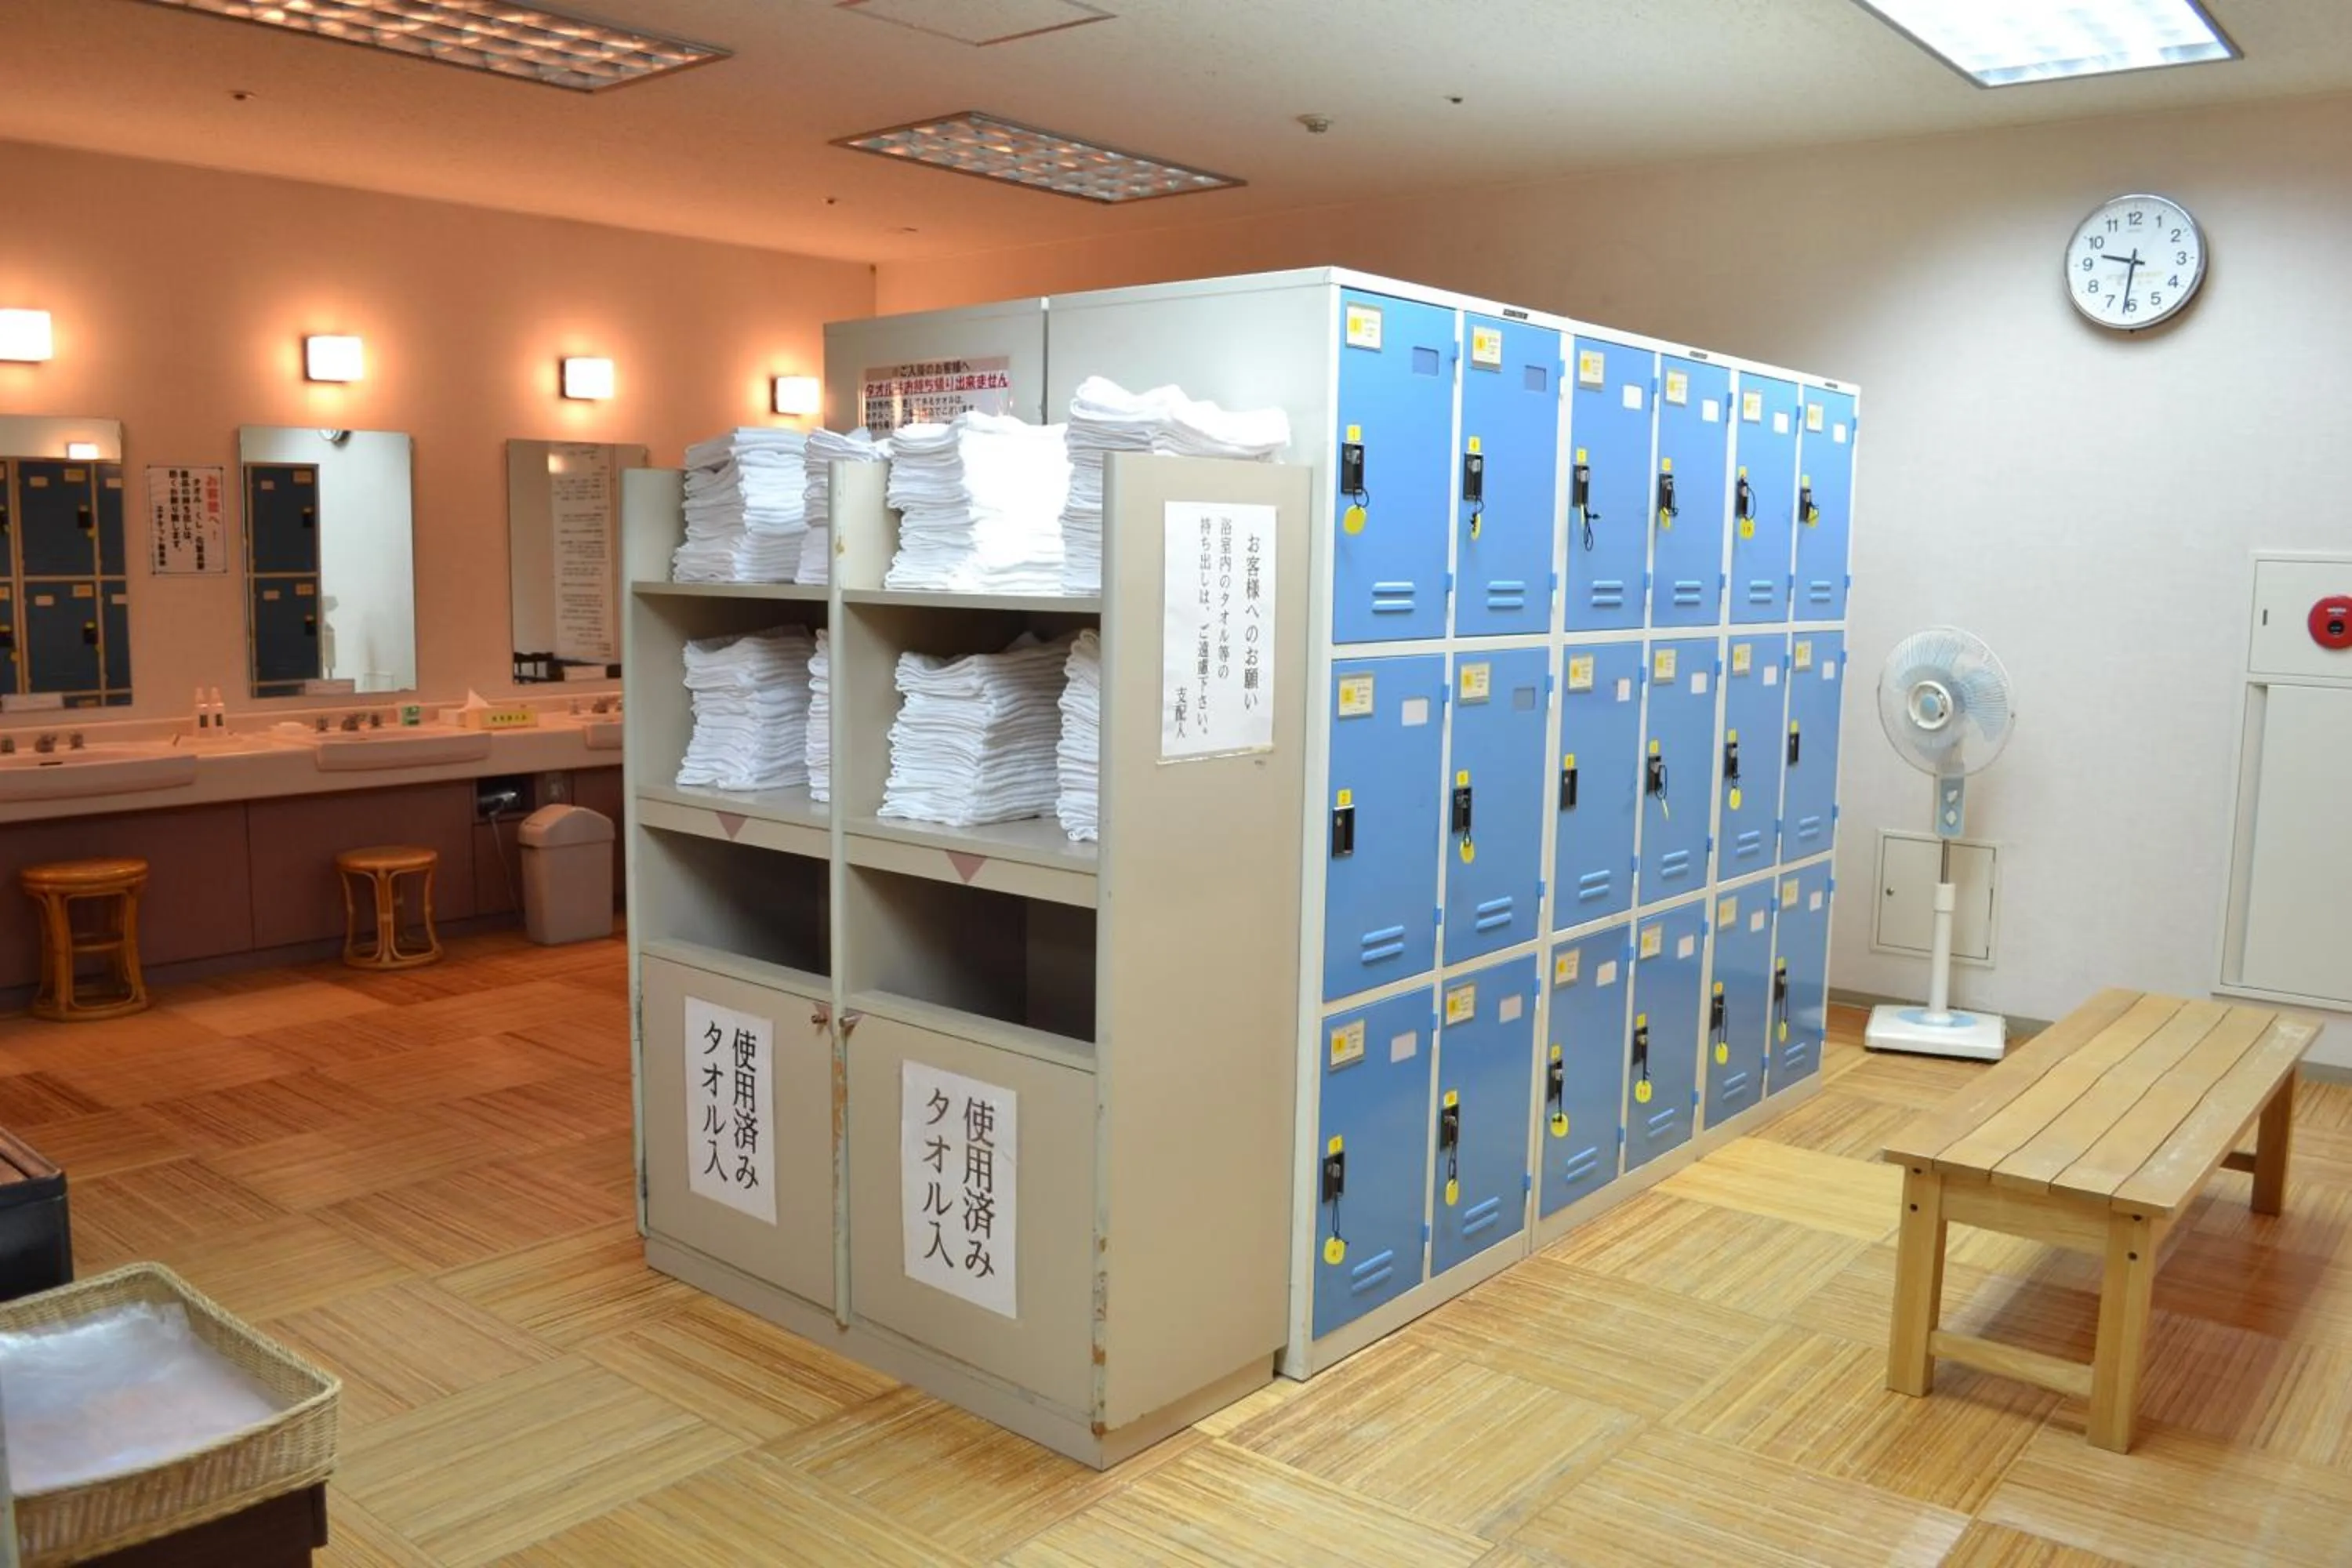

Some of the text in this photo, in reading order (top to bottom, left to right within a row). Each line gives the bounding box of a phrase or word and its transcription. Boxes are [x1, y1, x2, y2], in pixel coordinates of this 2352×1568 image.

[2128, 211, 2143, 226] 12
[2156, 215, 2162, 227] 1
[2107, 219, 2118, 233] 11
[2089, 235, 2104, 249] 10
[2170, 229, 2181, 243] 2
[2082, 257, 2093, 271] 9
[2176, 252, 2187, 265] 3
[2088, 279, 2099, 293] 8
[2168, 274, 2179, 288] 4
[2105, 295, 2115, 308] 7
[2126, 298, 2137, 312] 6
[2150, 292, 2161, 305] 5
[1218, 517, 1232, 680] 浴室内のタオル等の
[1244, 534, 1261, 710] お客様へのお願い
[1175, 687, 1188, 739] 支配人
[702, 1020, 728, 1181] タオル入
[732, 1028, 759, 1189] 使用済み
[923, 1087, 954, 1269] タオル入
[963, 1097, 995, 1278] 使用済み
